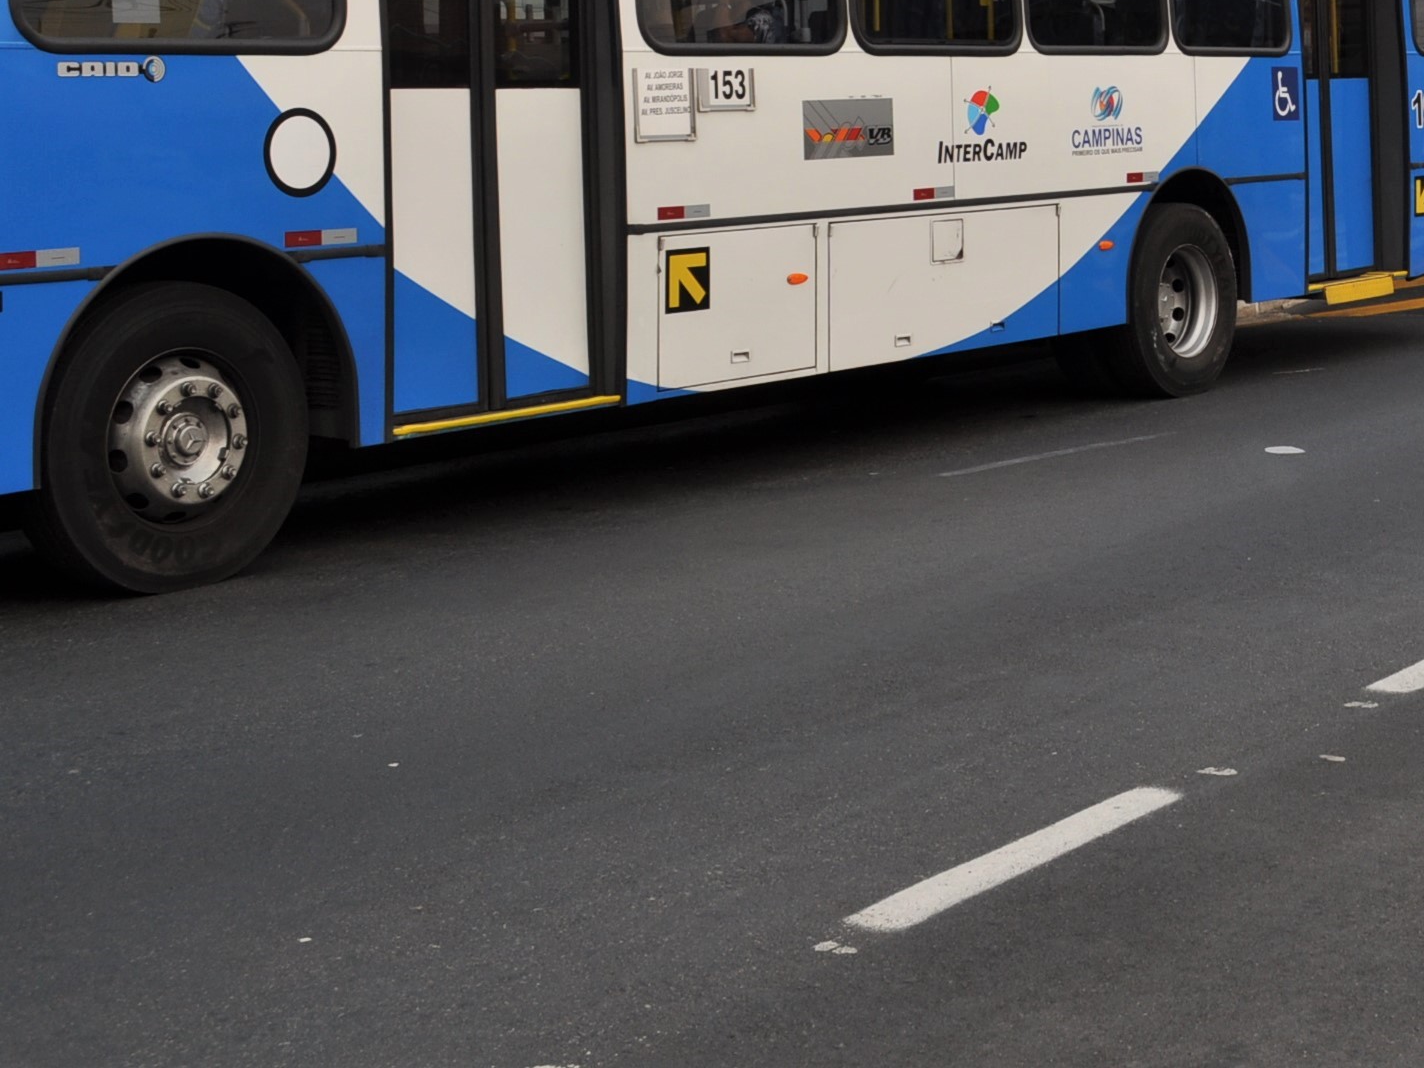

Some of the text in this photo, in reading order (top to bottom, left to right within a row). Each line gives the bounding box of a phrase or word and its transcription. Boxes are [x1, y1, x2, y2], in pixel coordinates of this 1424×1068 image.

[58, 61, 139, 77] CAIO
[655, 82, 684, 91] AMOREIRAS
[710, 70, 746, 100] 153
[1072, 127, 1143, 148] CAMPINAS
